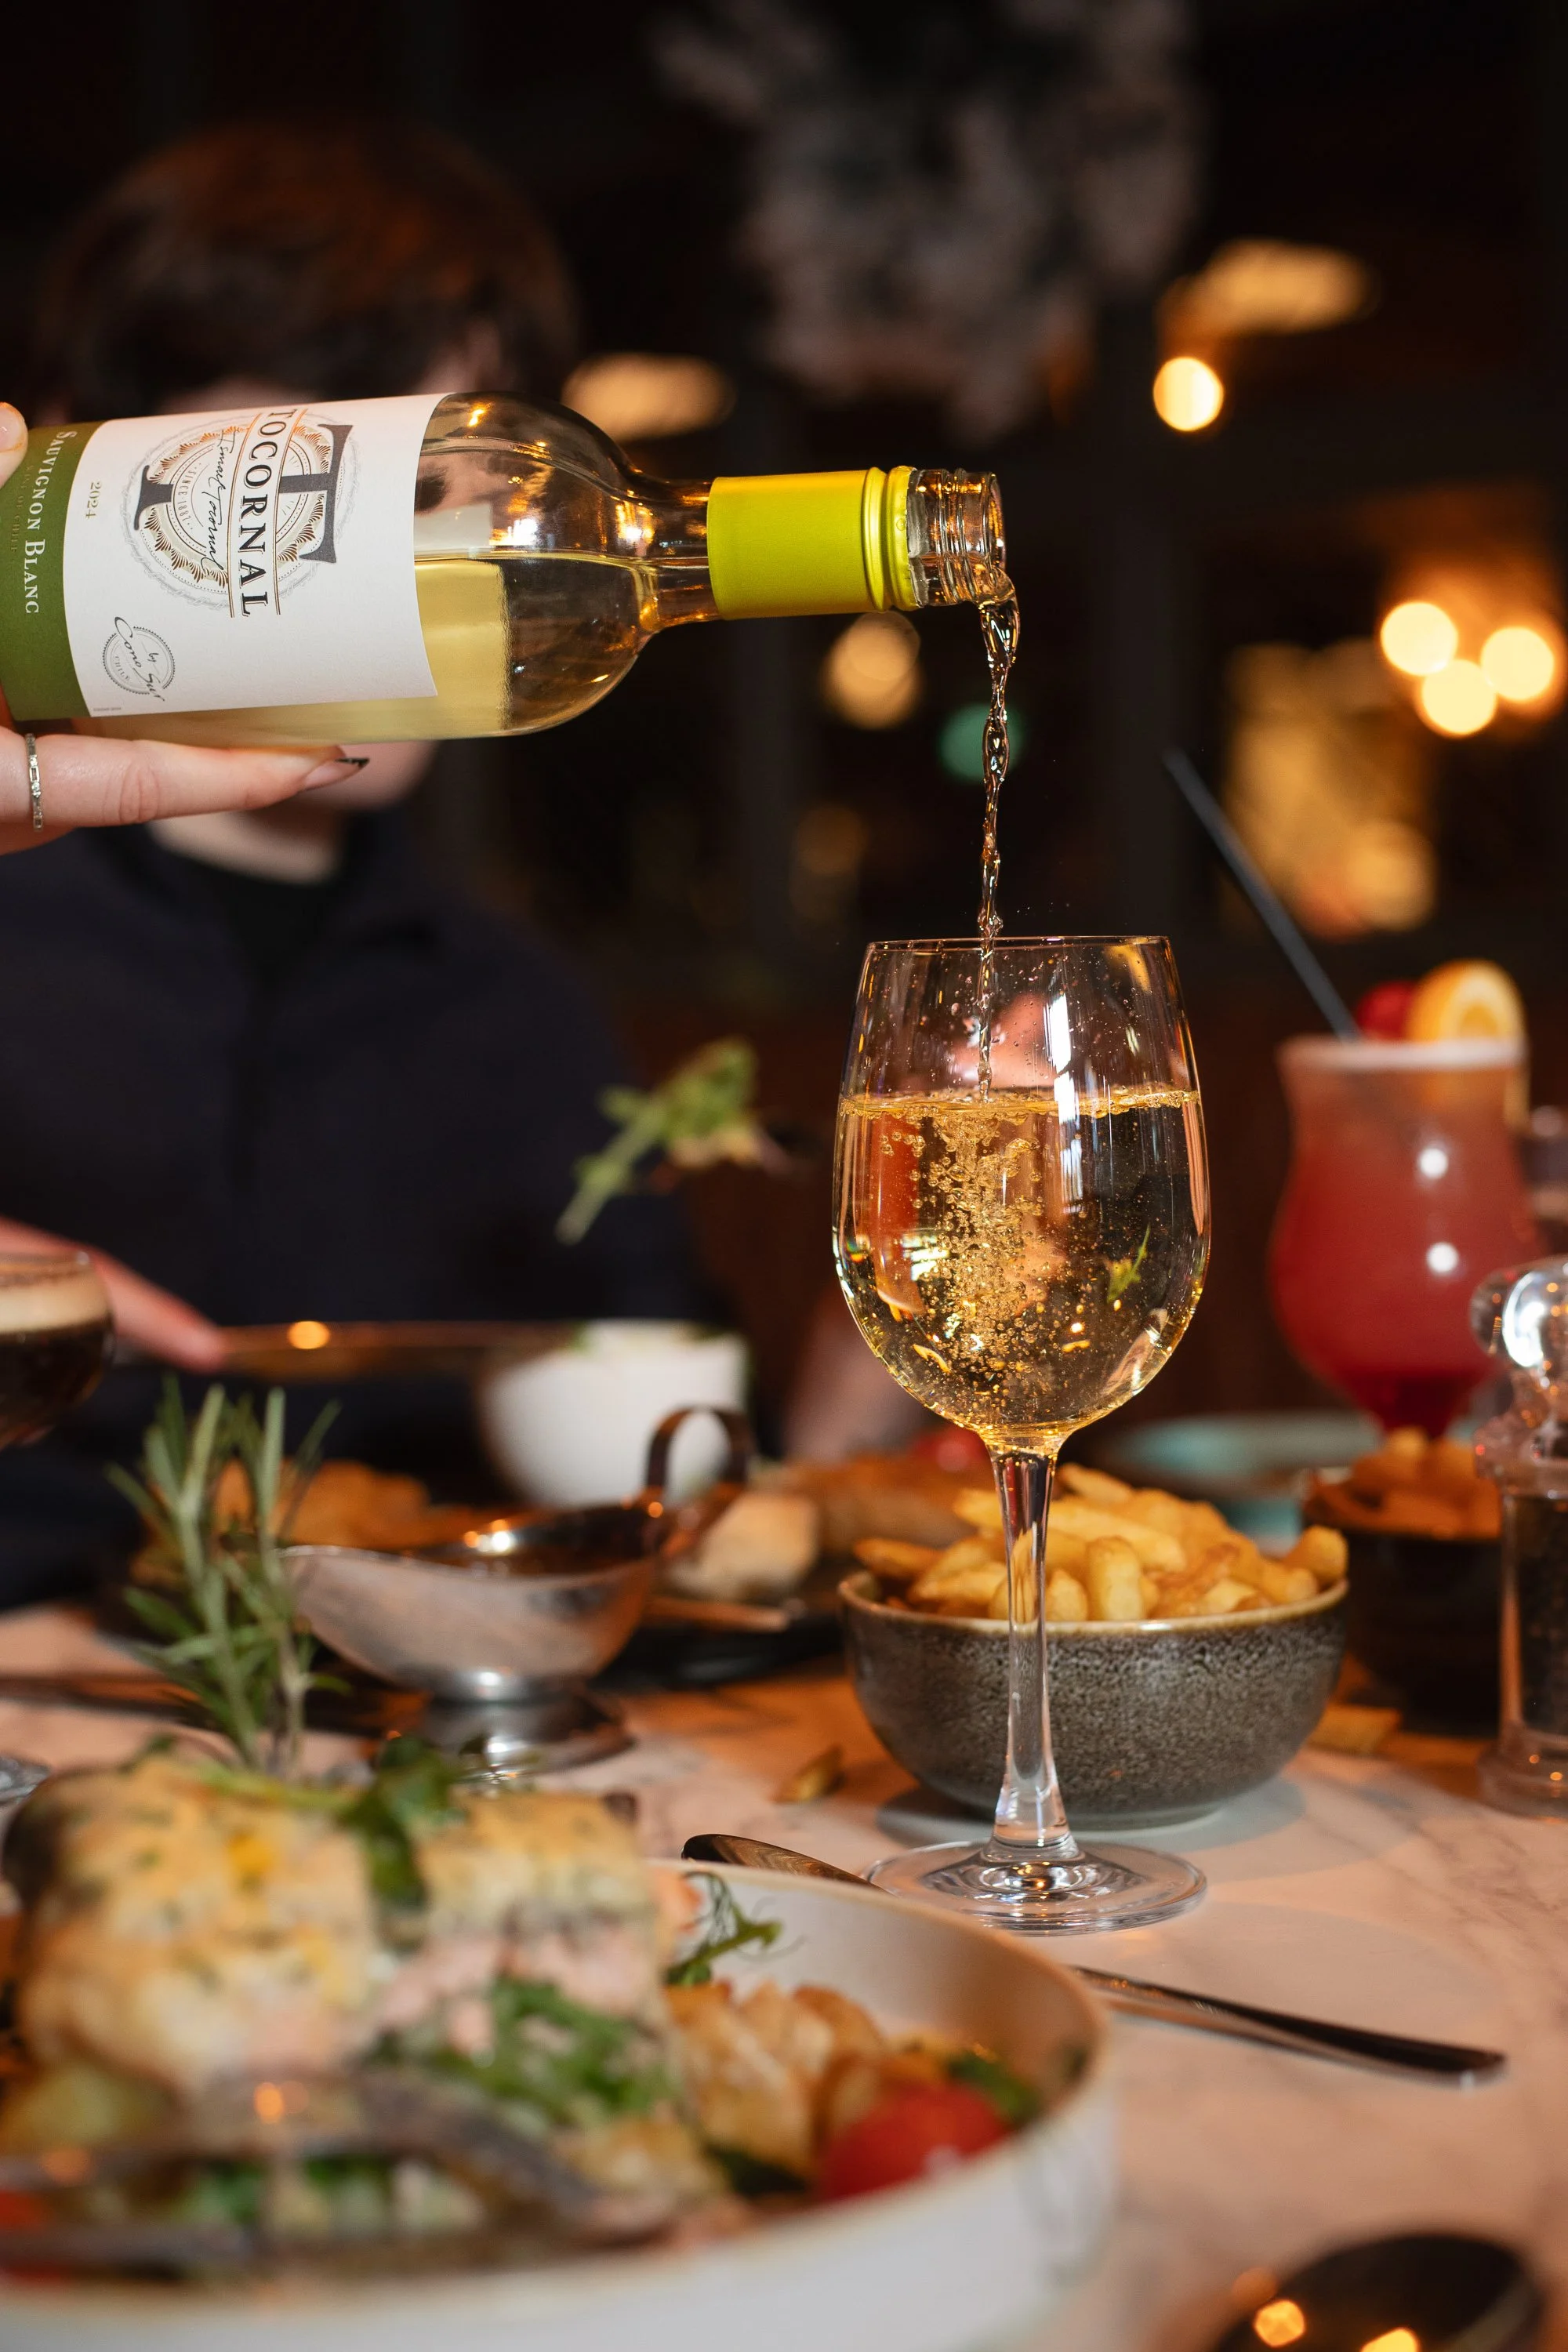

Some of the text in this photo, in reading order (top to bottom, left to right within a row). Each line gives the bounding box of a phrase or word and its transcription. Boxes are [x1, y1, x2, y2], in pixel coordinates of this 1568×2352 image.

[24, 431, 78, 613] SAUVIGNON BLANC
[85, 481, 102, 519] 2024
[177, 470, 196, 521] SINCE 1887
[201, 430, 234, 577] Ismael Tocornal
[237, 408, 298, 616] TOCORNAL
[114, 616, 165, 702] Cono Sur
[147, 652, 159, 662] by
